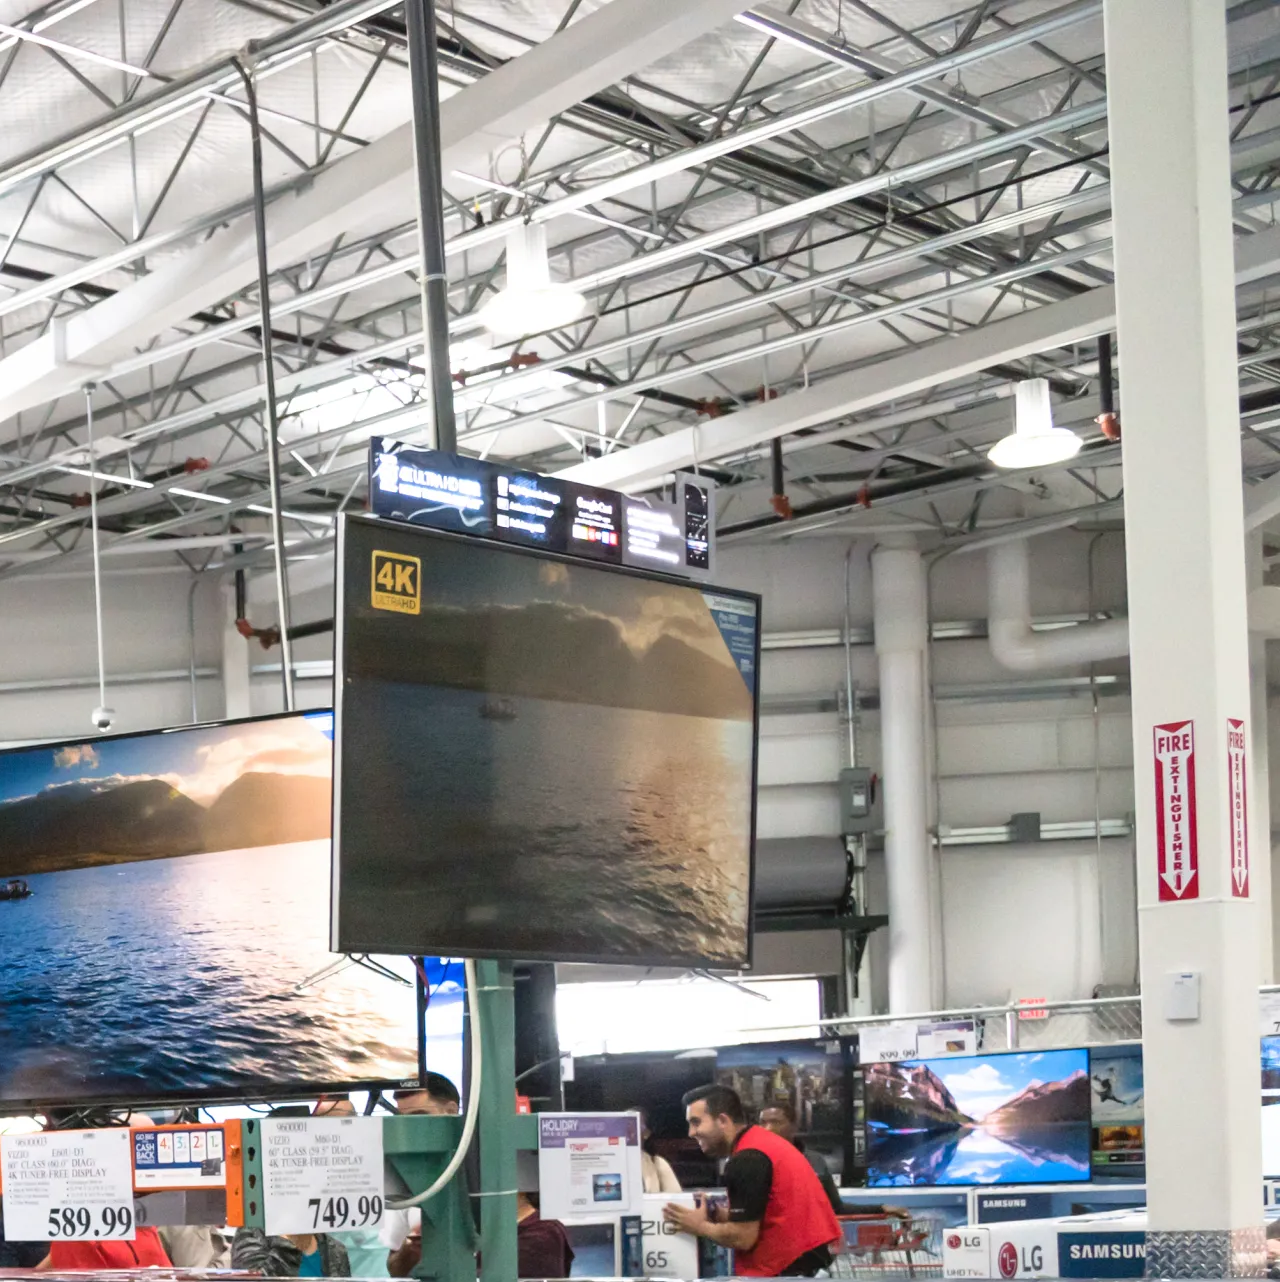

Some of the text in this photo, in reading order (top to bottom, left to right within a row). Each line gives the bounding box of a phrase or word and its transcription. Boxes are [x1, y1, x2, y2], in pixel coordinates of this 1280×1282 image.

[377, 562, 415, 595] 4K
[1158, 733, 1190, 754] FIRE
[1229, 731, 1244, 750] FIRE
[1169, 755, 1183, 871] EXTINGUISHER
[542, 1119, 579, 1132] HOLIDAY
[282, 1147, 308, 1156] CLASS
[21, 1160, 46, 1169] CLASS
[331, 1156, 364, 1165] DISPLAY
[71, 1168, 107, 1178] DISPLAY
[982, 1198, 1027, 1208] SAMSUNG
[308, 1195, 383, 1229] 749.99
[47, 1206, 132, 1237] 589.99
[964, 1236, 981, 1248] LG
[646, 1251, 668, 1269] 65
[1022, 1245, 1044, 1273] LG
[1070, 1243, 1147, 1260] SAMSUN
